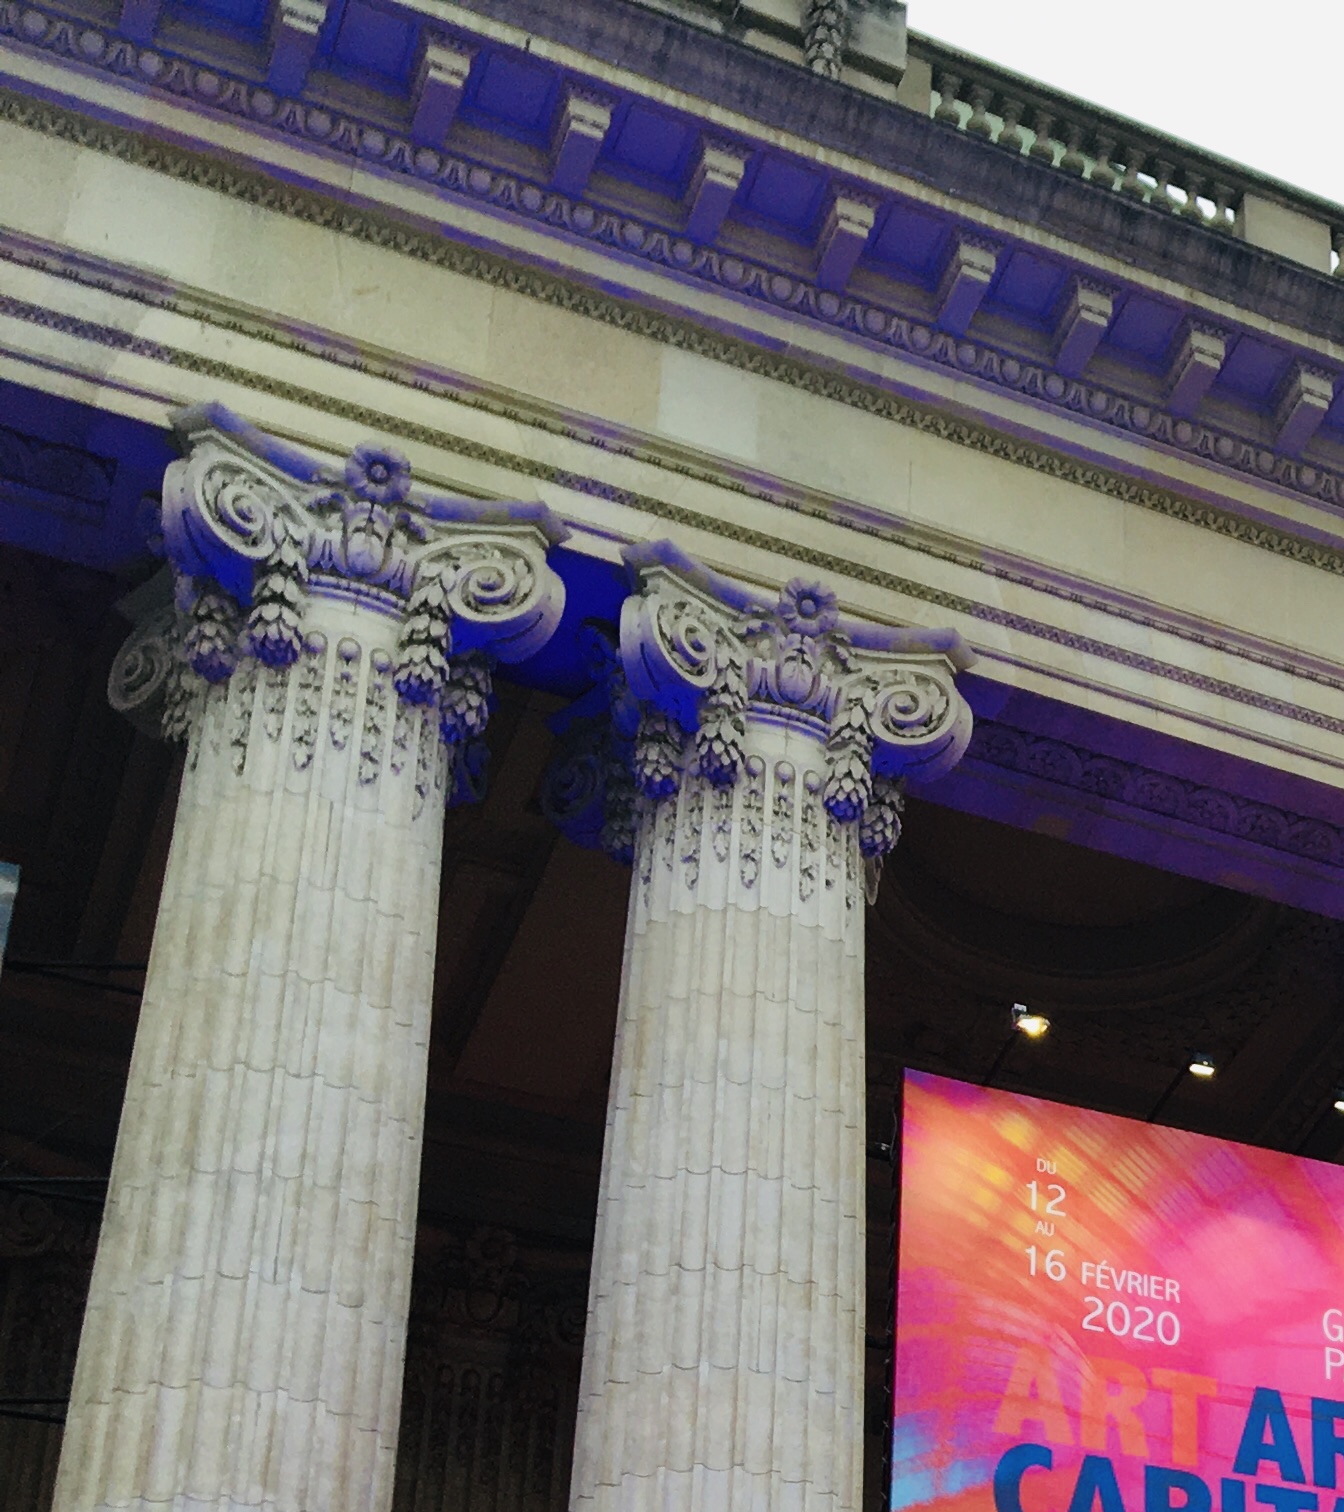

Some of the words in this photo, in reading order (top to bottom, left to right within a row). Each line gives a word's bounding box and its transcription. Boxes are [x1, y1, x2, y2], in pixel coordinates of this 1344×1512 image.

[1036, 1158, 1057, 1175] DU
[1026, 1180, 1067, 1217] 12
[1035, 1221, 1055, 1237] AU
[1025, 1245, 1067, 1282] 16
[1081, 1260, 1181, 1304] FÉVRIER
[1082, 1296, 1181, 1346] 2020
[992, 1342, 1218, 1468] ART
